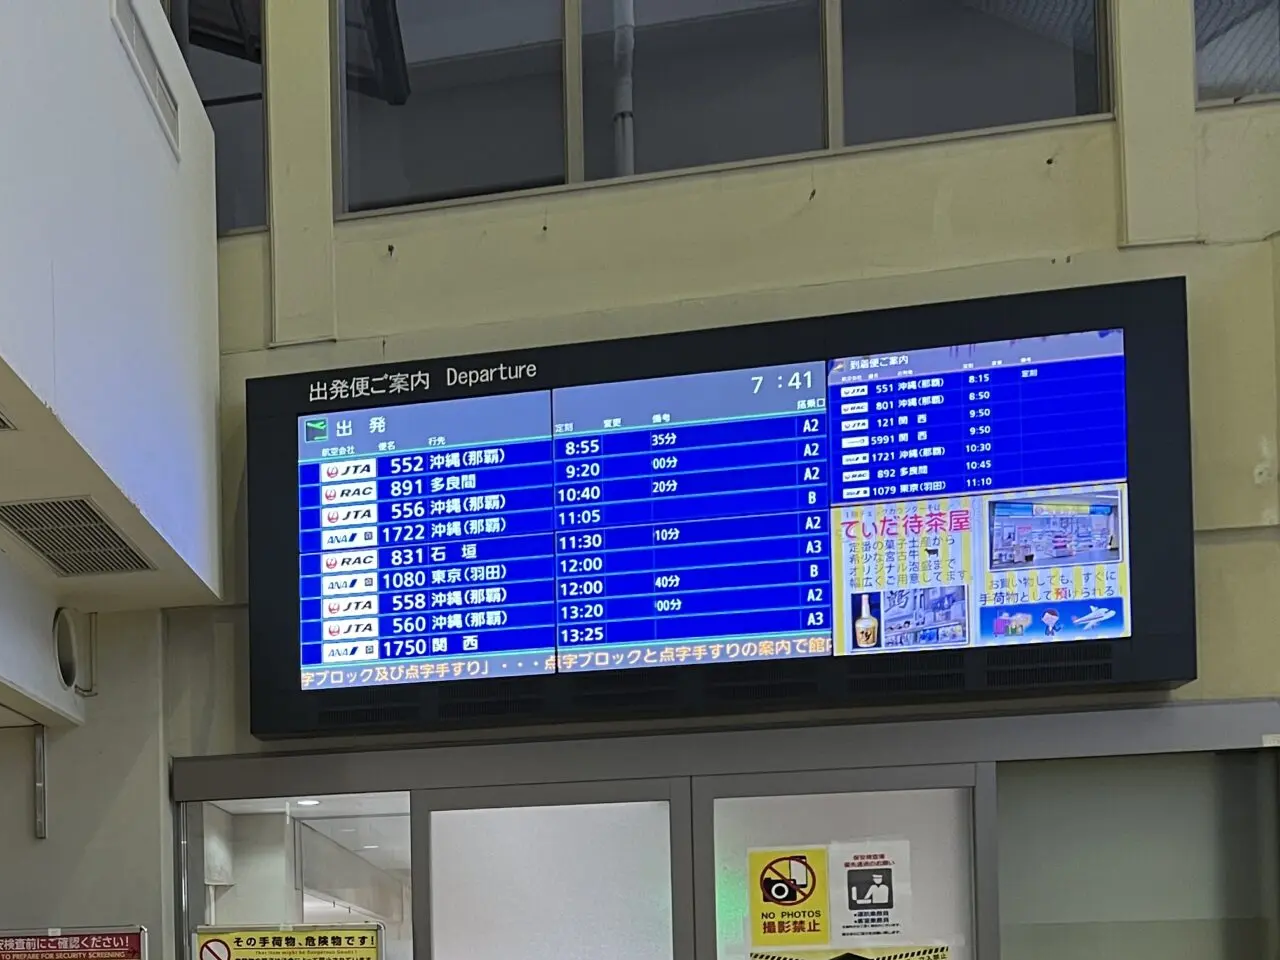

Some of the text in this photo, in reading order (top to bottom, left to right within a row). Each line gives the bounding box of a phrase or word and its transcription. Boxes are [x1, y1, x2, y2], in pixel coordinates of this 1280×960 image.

[849, 355, 909, 371] 到着便ご案内
[309, 363, 537, 402] 出発便ご案内 Departure
[875, 384, 894, 394] 551
[968, 373, 990, 384] 8:15
[875, 401, 894, 412] 801
[969, 391, 991, 402] 8:50
[877, 417, 894, 428] 121
[969, 408, 991, 419] 9:50
[428, 436, 446, 447] 行先
[554, 422, 574, 433] 定刻
[871, 425, 991, 446] 5991 9:50
[340, 418, 820, 477] JTA 552 沖縄(那覇) 8:55 35分 A2
[872, 452, 895, 462] 1721
[966, 443, 992, 453] 10:30
[340, 442, 820, 498] RAC 891 多良間 9:20 00分 A2
[877, 469, 896, 479] 892
[966, 460, 992, 470] 10:45
[342, 466, 821, 521] JTA 556 沖縄(那覇) 10:40 20分 A2
[872, 486, 897, 496] 1079
[967, 477, 993, 487] 11:10
[382, 524, 426, 543] 1722
[430, 517, 507, 539] 沖縄(那覇)
[559, 509, 601, 526] 11:05
[808, 491, 817, 504] B
[340, 555, 374, 566] RAC
[391, 547, 424, 566] 831
[559, 533, 603, 550] 11:30
[654, 527, 680, 542] 10分
[805, 516, 822, 530] A2
[383, 571, 426, 589] 1080
[431, 564, 507, 585] 東京(羽田)
[560, 557, 603, 573] 12:00
[806, 540, 822, 554] A3
[342, 564, 819, 612] JTA 558 沖縄(那覇) 12:00 40分 B
[343, 588, 823, 635] JTA 560 沖縄(那覇) 13:20 00分 A2
[383, 639, 427, 658] 1750
[561, 626, 604, 643] 13:25
[807, 611, 824, 626] A3
[761, 909, 822, 920] NO PHOTOS
[762, 920, 822, 934] 撮影禁止
[233, 935, 376, 947] その手荷物、危険物です!
[55, 952, 86, 960] SECURITY
[88, 951, 126, 959] SCREENING
